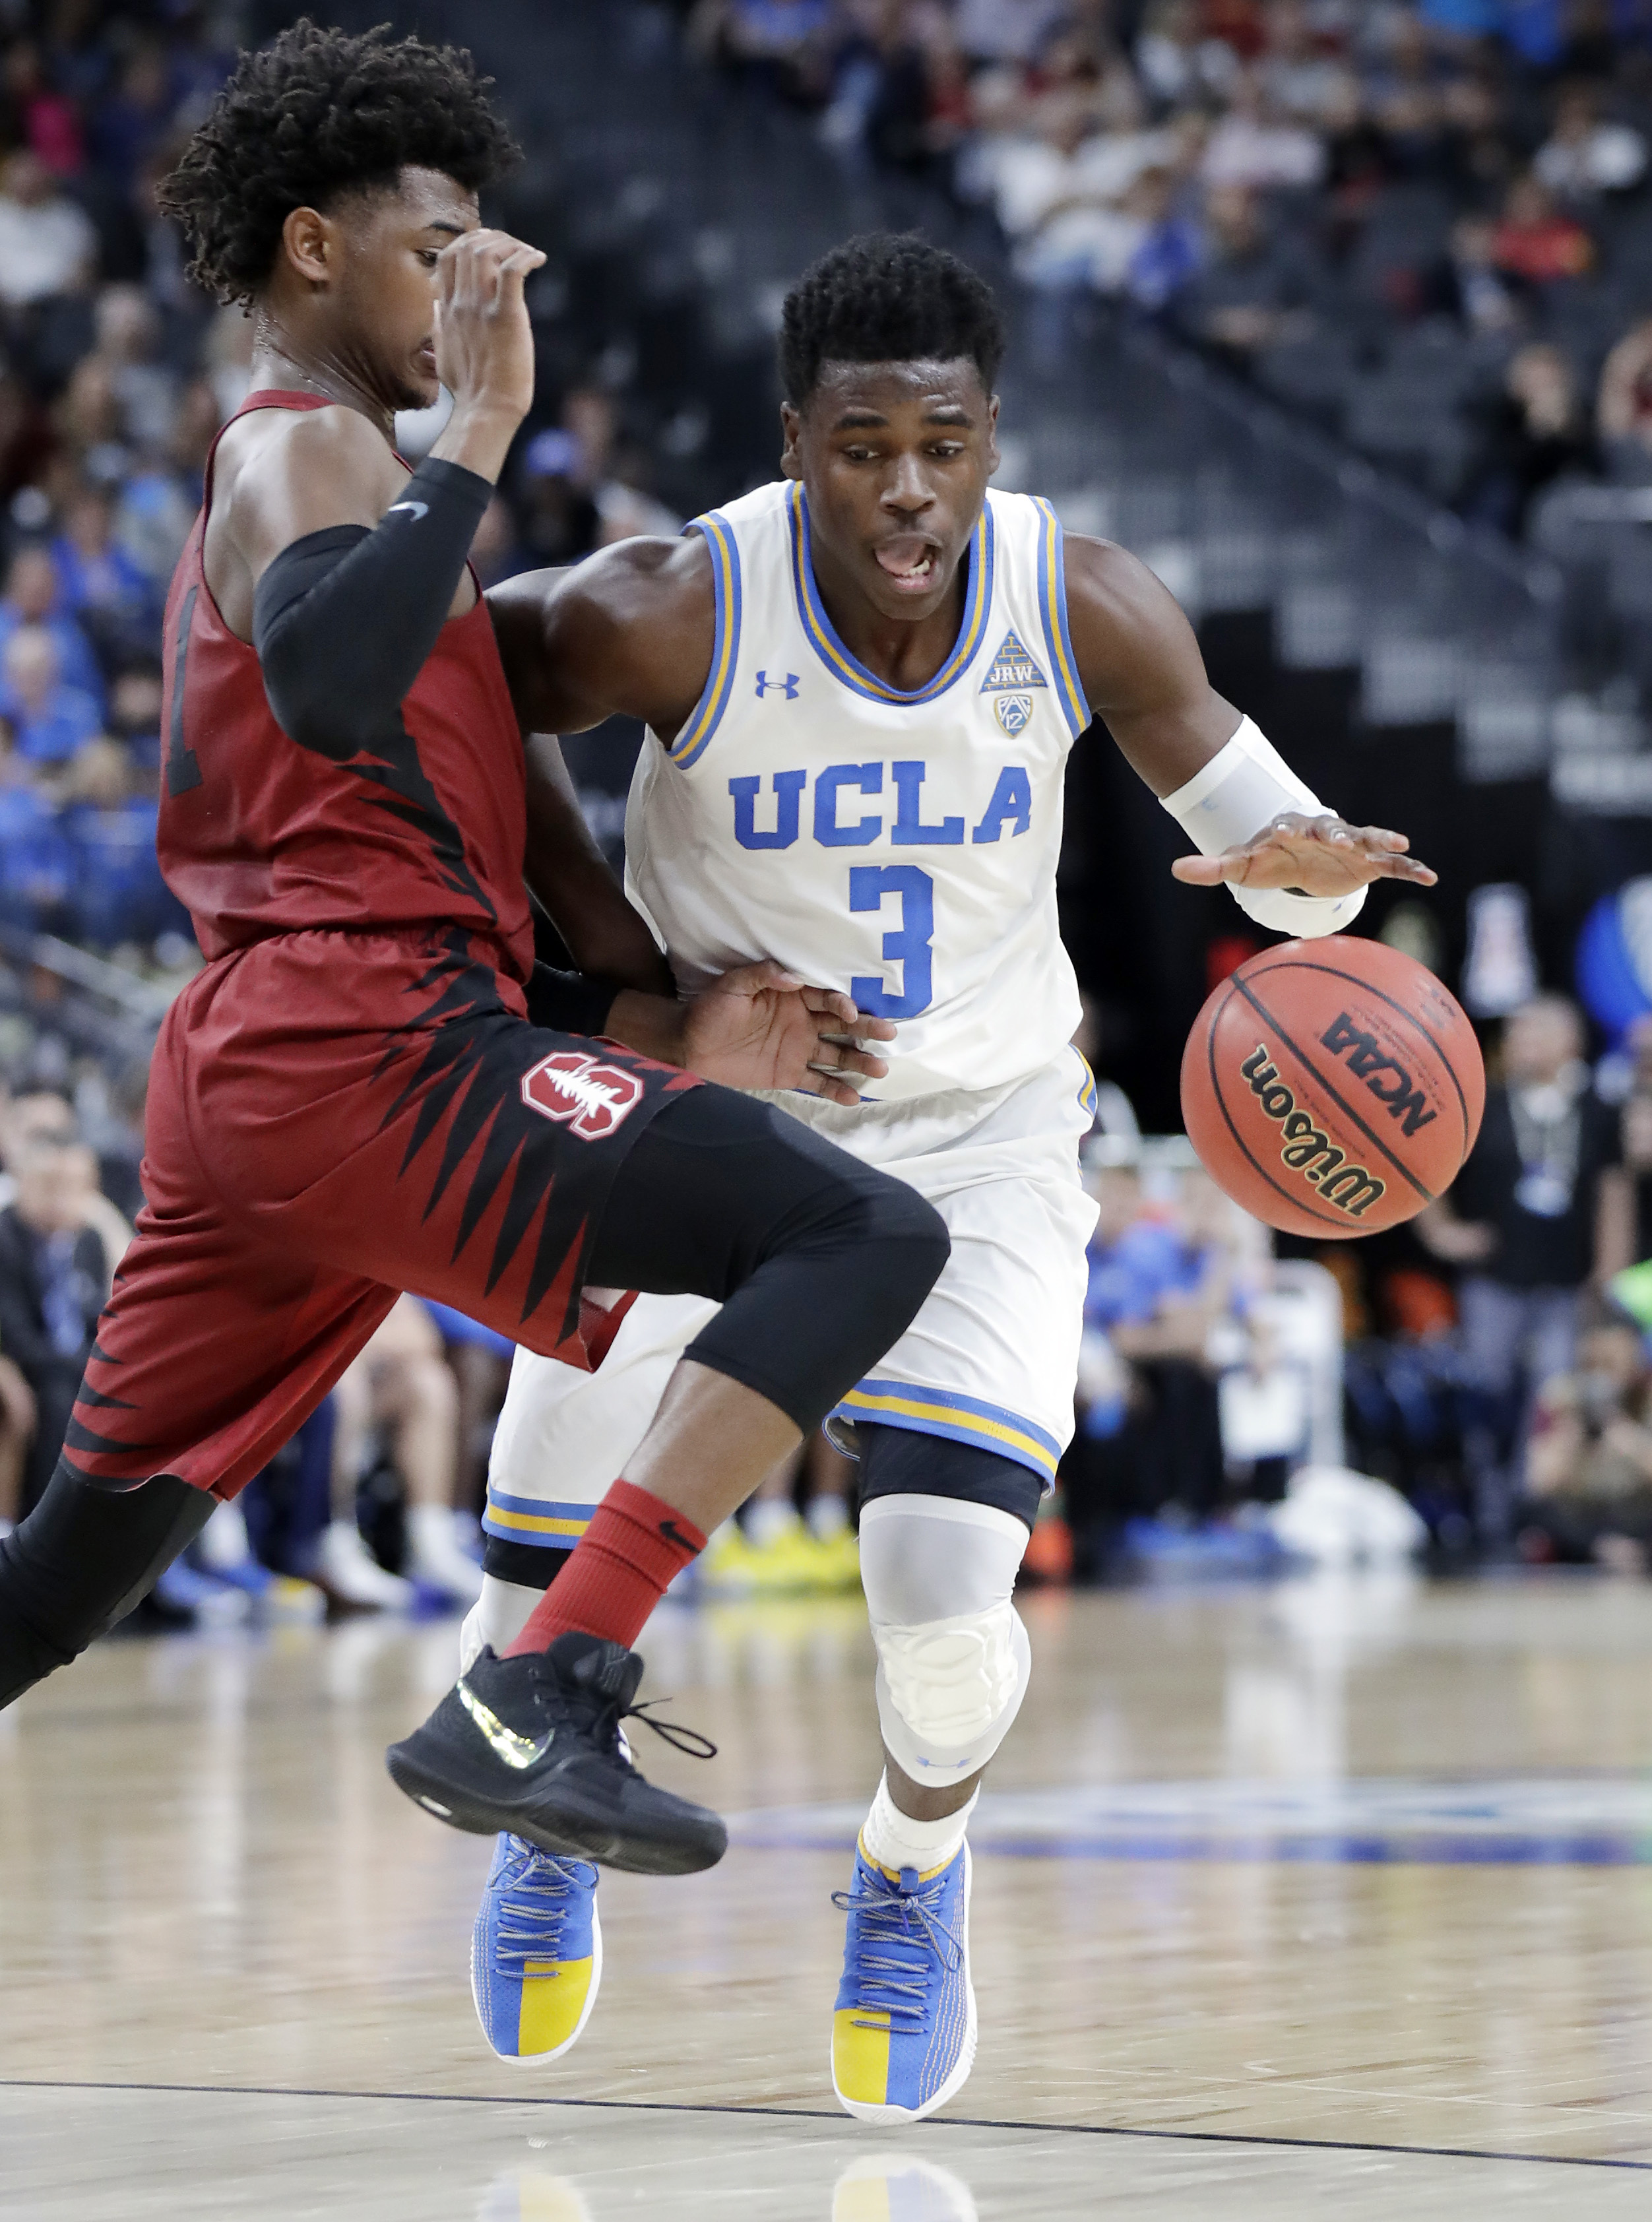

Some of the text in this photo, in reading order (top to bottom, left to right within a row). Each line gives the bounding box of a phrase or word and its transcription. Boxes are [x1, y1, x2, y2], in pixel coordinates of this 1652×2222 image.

[990, 665, 1033, 683] JRW
[997, 695, 1031, 722] PAC
[1005, 713, 1023, 730] 12
[728, 761, 1032, 850] UCLA
[849, 864, 934, 1020] 3
[1321, 1011, 1438, 1137] NCAA
[1240, 1042, 1386, 1218] Wilson
